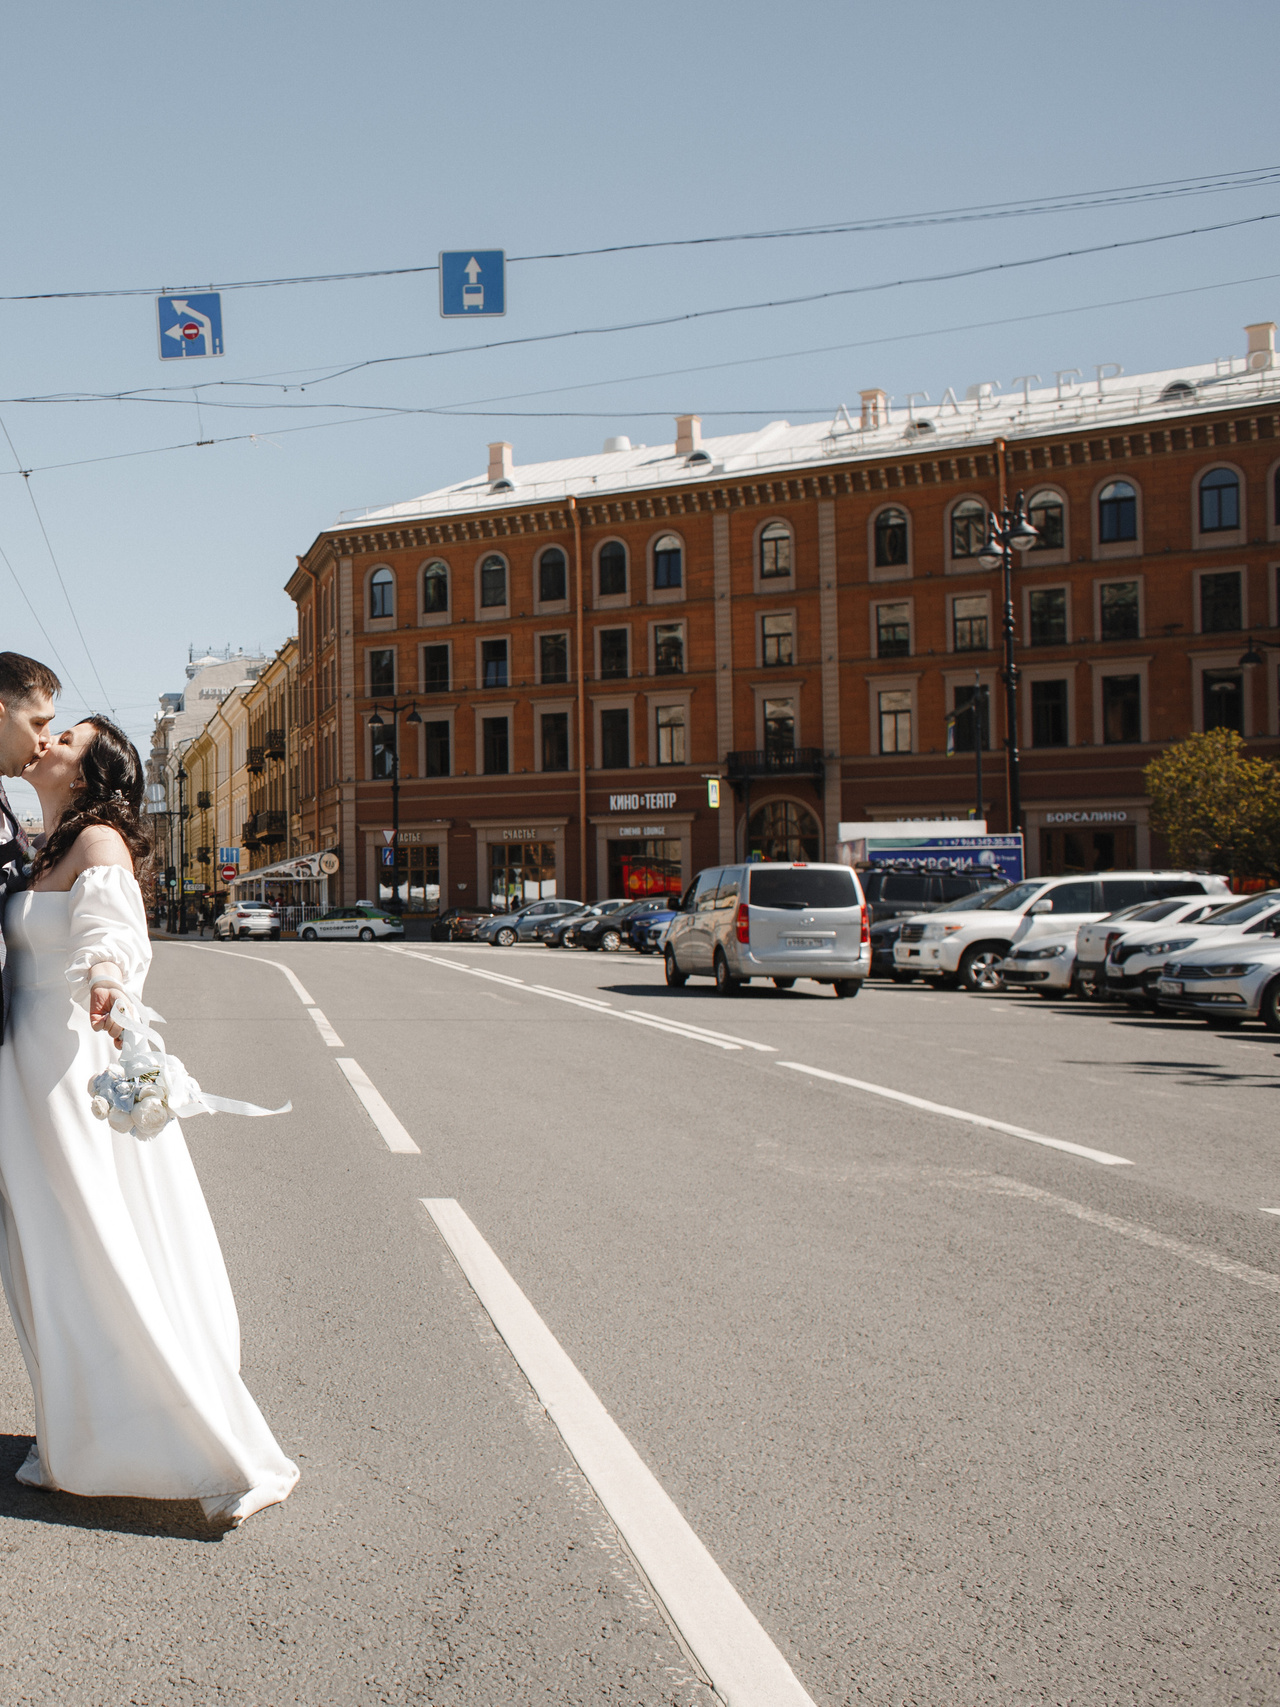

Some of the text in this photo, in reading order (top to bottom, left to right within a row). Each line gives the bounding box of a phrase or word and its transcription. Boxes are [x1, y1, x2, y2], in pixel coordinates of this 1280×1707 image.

[1046, 811, 1127, 823] БОРСАЛИНО
[502, 828, 536, 840] СЧАСТЬЕ
[619, 826, 665, 837] CINEMA LOUNGE
